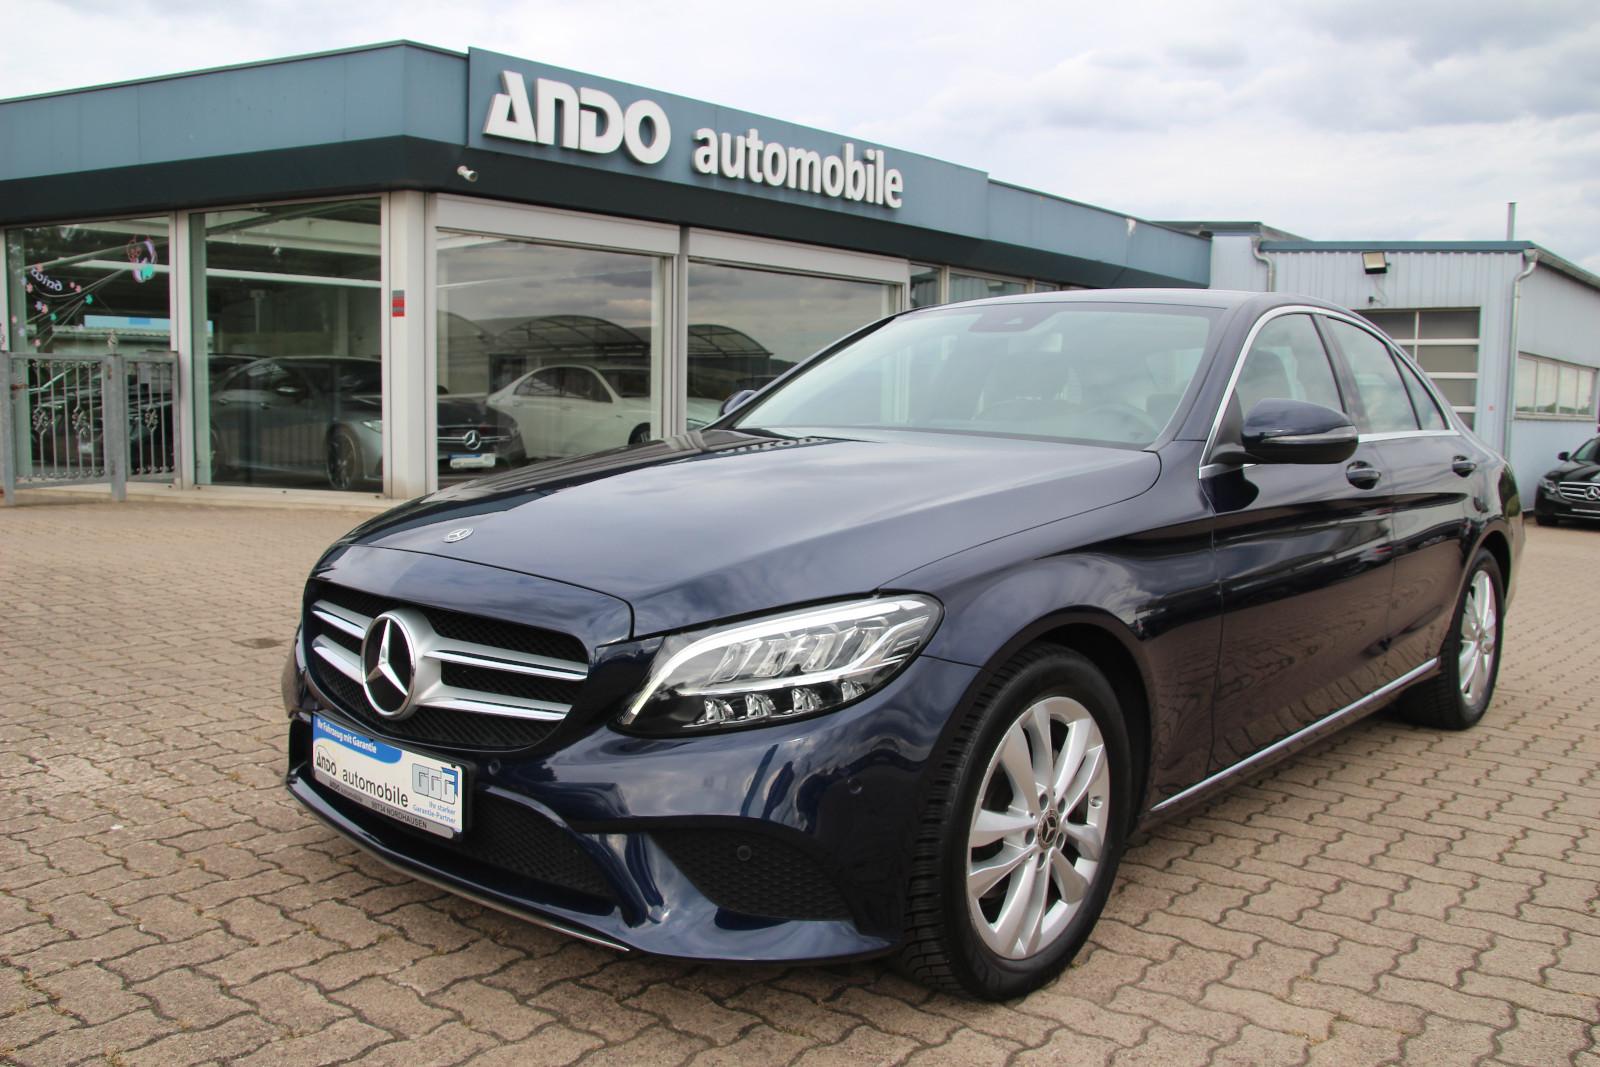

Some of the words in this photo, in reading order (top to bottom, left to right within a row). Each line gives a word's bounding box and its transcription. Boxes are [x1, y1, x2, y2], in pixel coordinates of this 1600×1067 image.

[691, 127, 903, 208] automobile
[352, 737, 377, 753] Garantie
[342, 768, 409, 807] automobile
[386, 805, 428, 829] NORDHAUSEN
